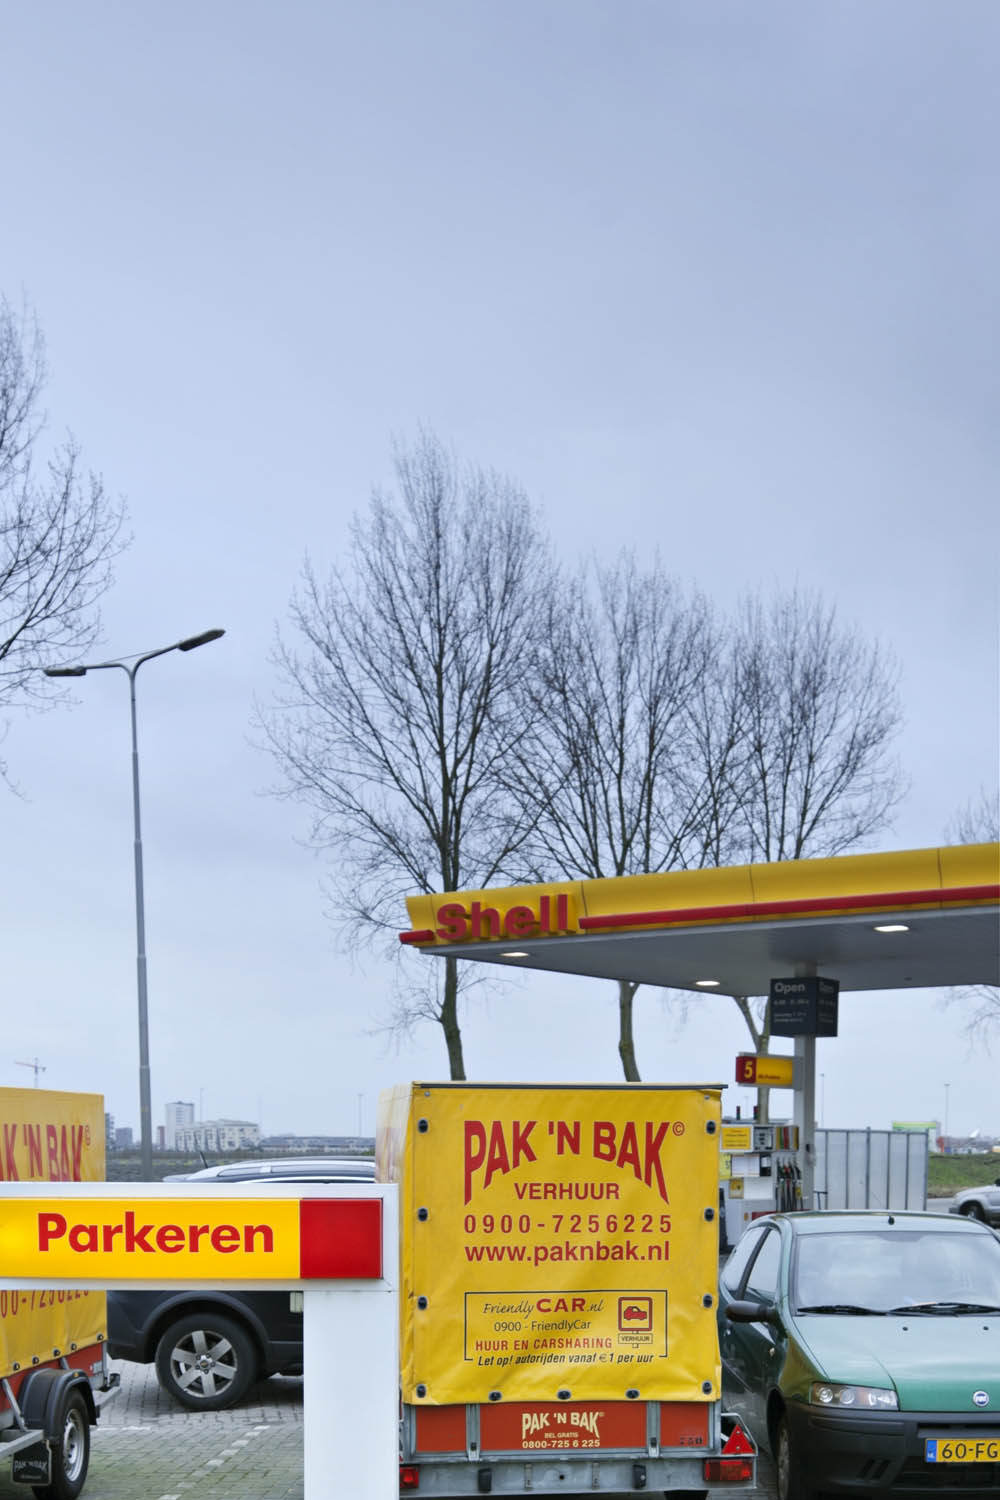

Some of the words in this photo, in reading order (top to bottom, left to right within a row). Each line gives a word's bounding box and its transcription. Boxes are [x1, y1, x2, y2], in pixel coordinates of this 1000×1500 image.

[436, 894, 568, 940] Shell
[774, 982, 805, 995] Open
[744, 1061, 753, 1079] 5
[463, 1120, 538, 1207] PAK
[548, 1121, 581, 1155] 'N
[592, 1121, 671, 1205] BAK
[514, 1182, 620, 1200] VERHUUR
[38, 1211, 274, 1253] Parkeren
[463, 1214, 672, 1234] 0900-7256225
[464, 1240, 670, 1267] www.paknbak.nl
[475, 1340, 509, 1352] HUUR
[514, 1339, 529, 1351] EN
[533, 1337, 613, 1351] CARSHARING
[478, 1355, 495, 1367] Let
[496, 1356, 513, 1368] op!
[515, 1353, 566, 1367] autorijden
[568, 1352, 597, 1364] vanaf
[617, 1354, 634, 1366] per
[636, 1355, 654, 1364] uur
[522, 1412, 551, 1439] PAK
[571, 1412, 600, 1439] BAK
[581, 1440, 600, 1449] 225
[941, 1443, 998, 1459] 60-FG
